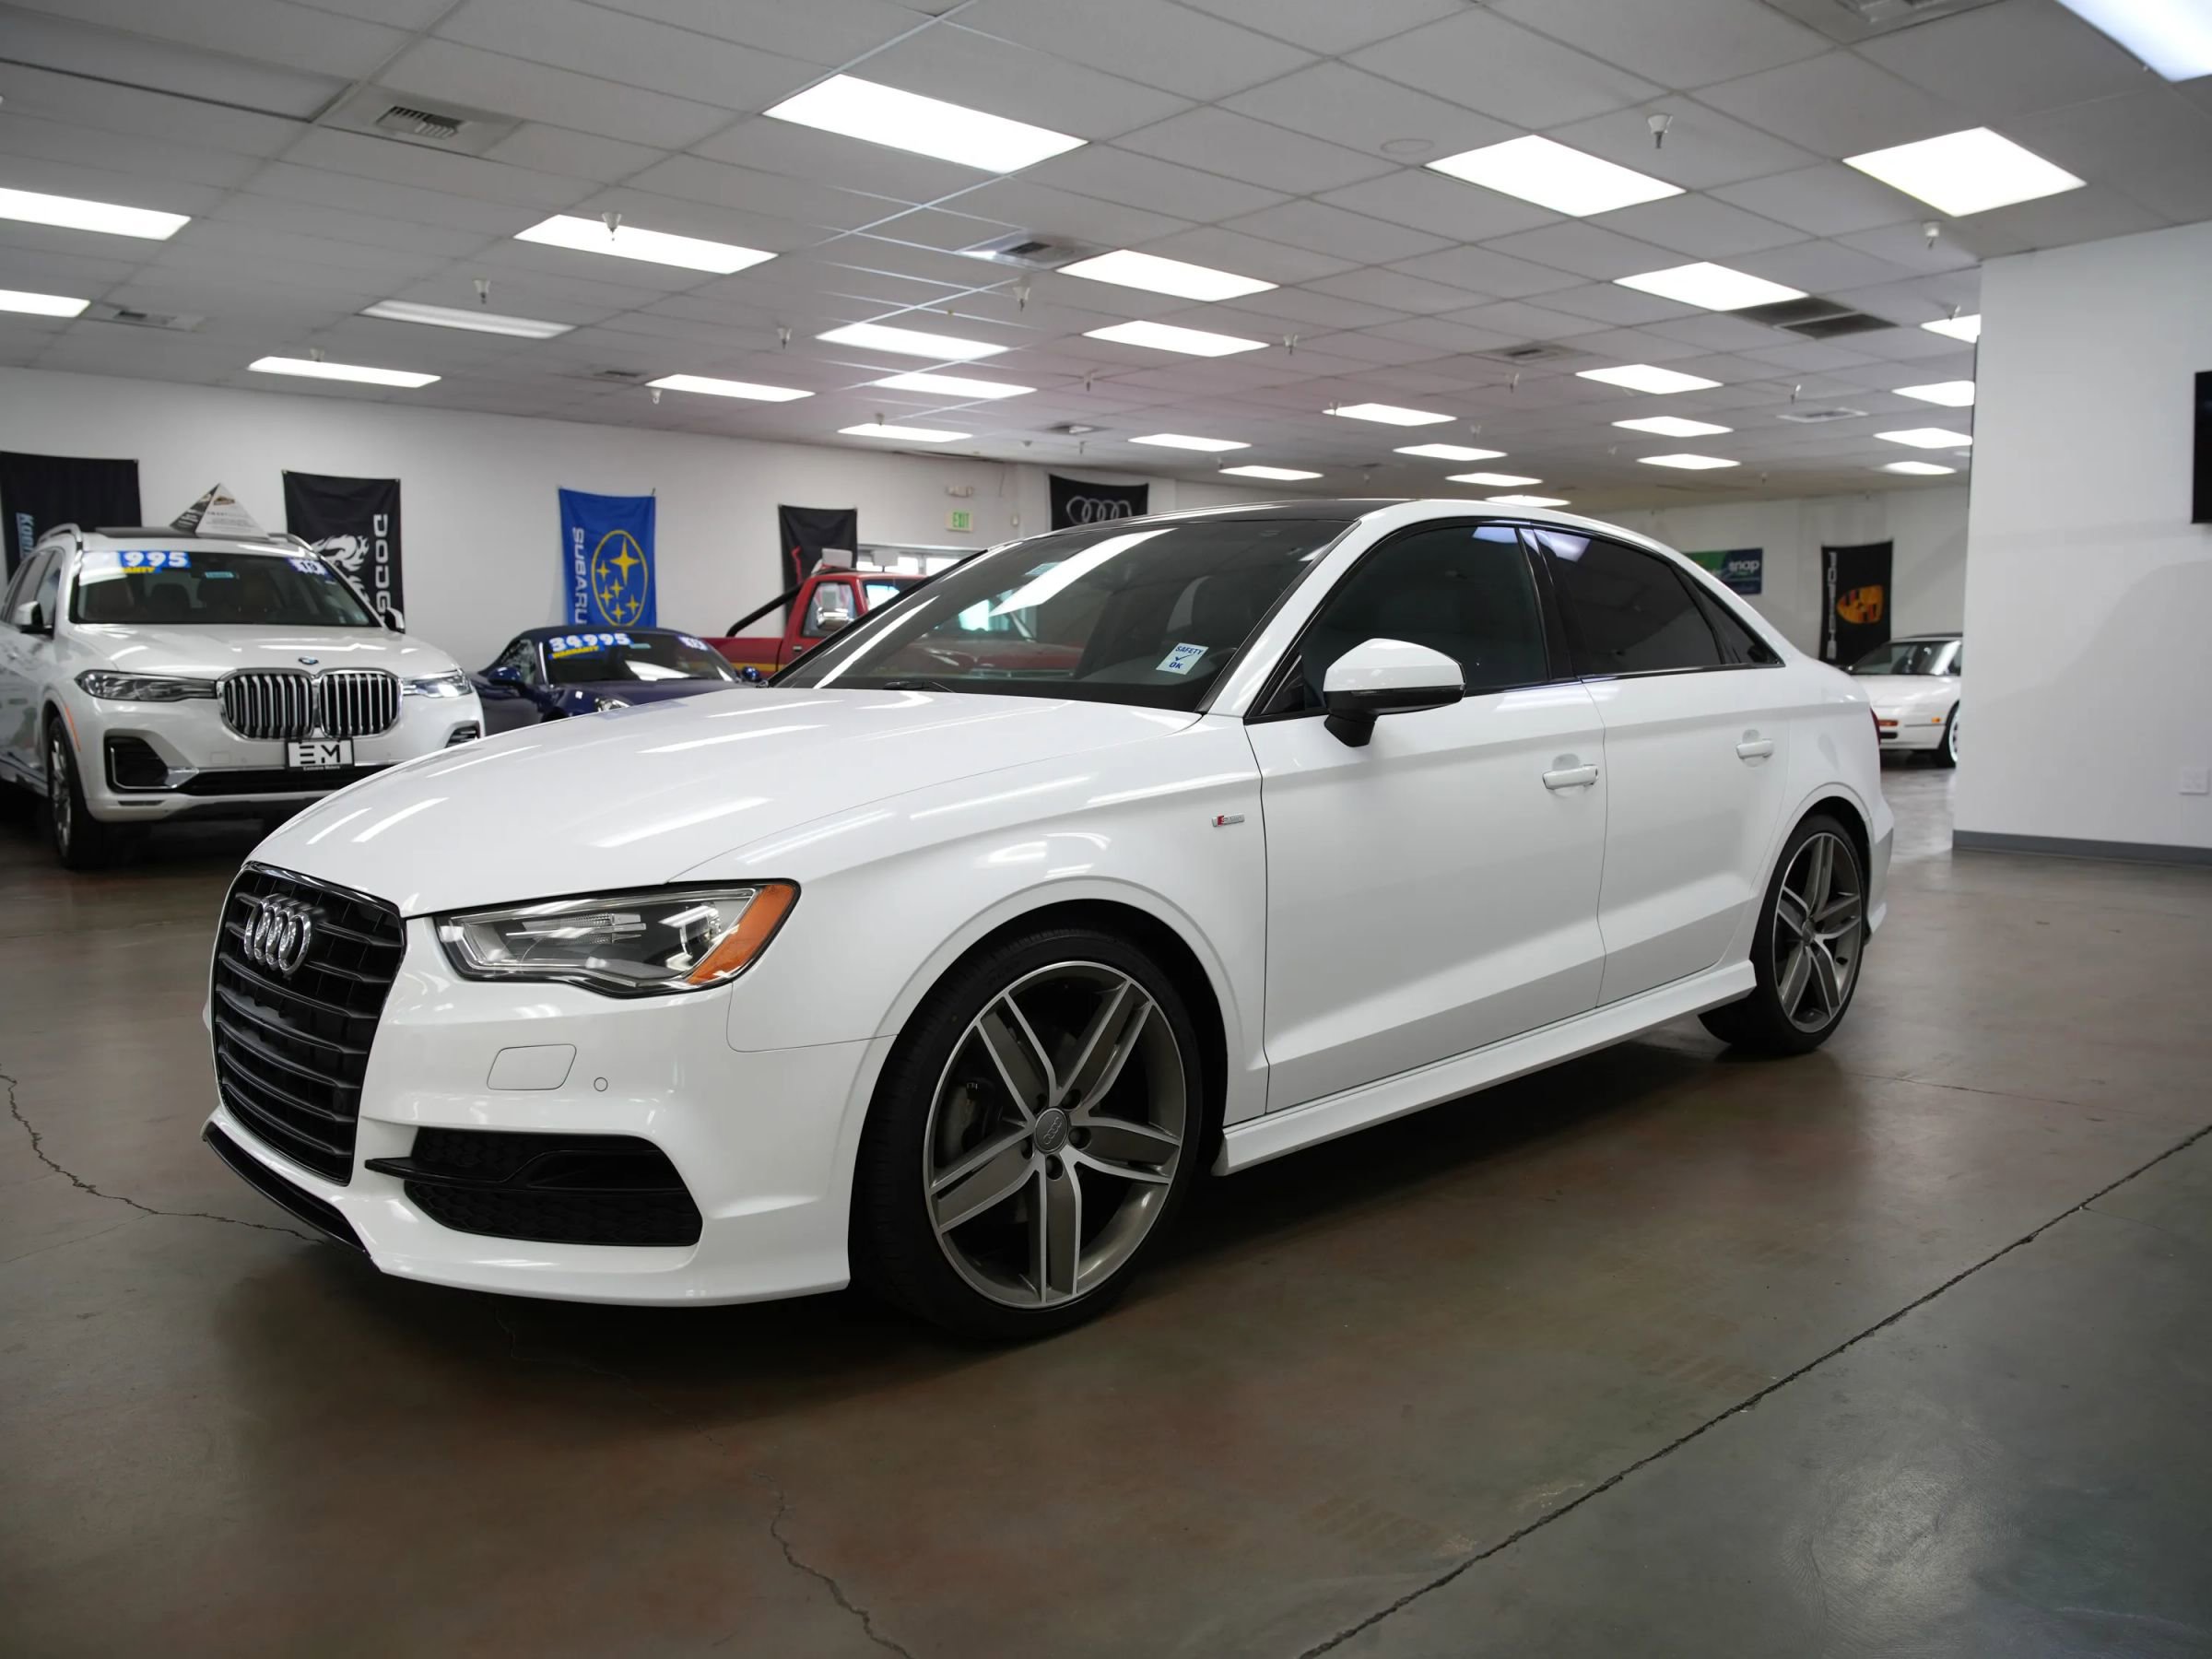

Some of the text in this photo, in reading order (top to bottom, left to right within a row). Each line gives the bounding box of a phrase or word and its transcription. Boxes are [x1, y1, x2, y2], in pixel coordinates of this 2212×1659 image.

[952, 512, 971, 528] EXIT
[373, 514, 391, 623] DODG
[572, 527, 588, 625] SUBARU
[1175, 646, 1204, 655] SAFETY
